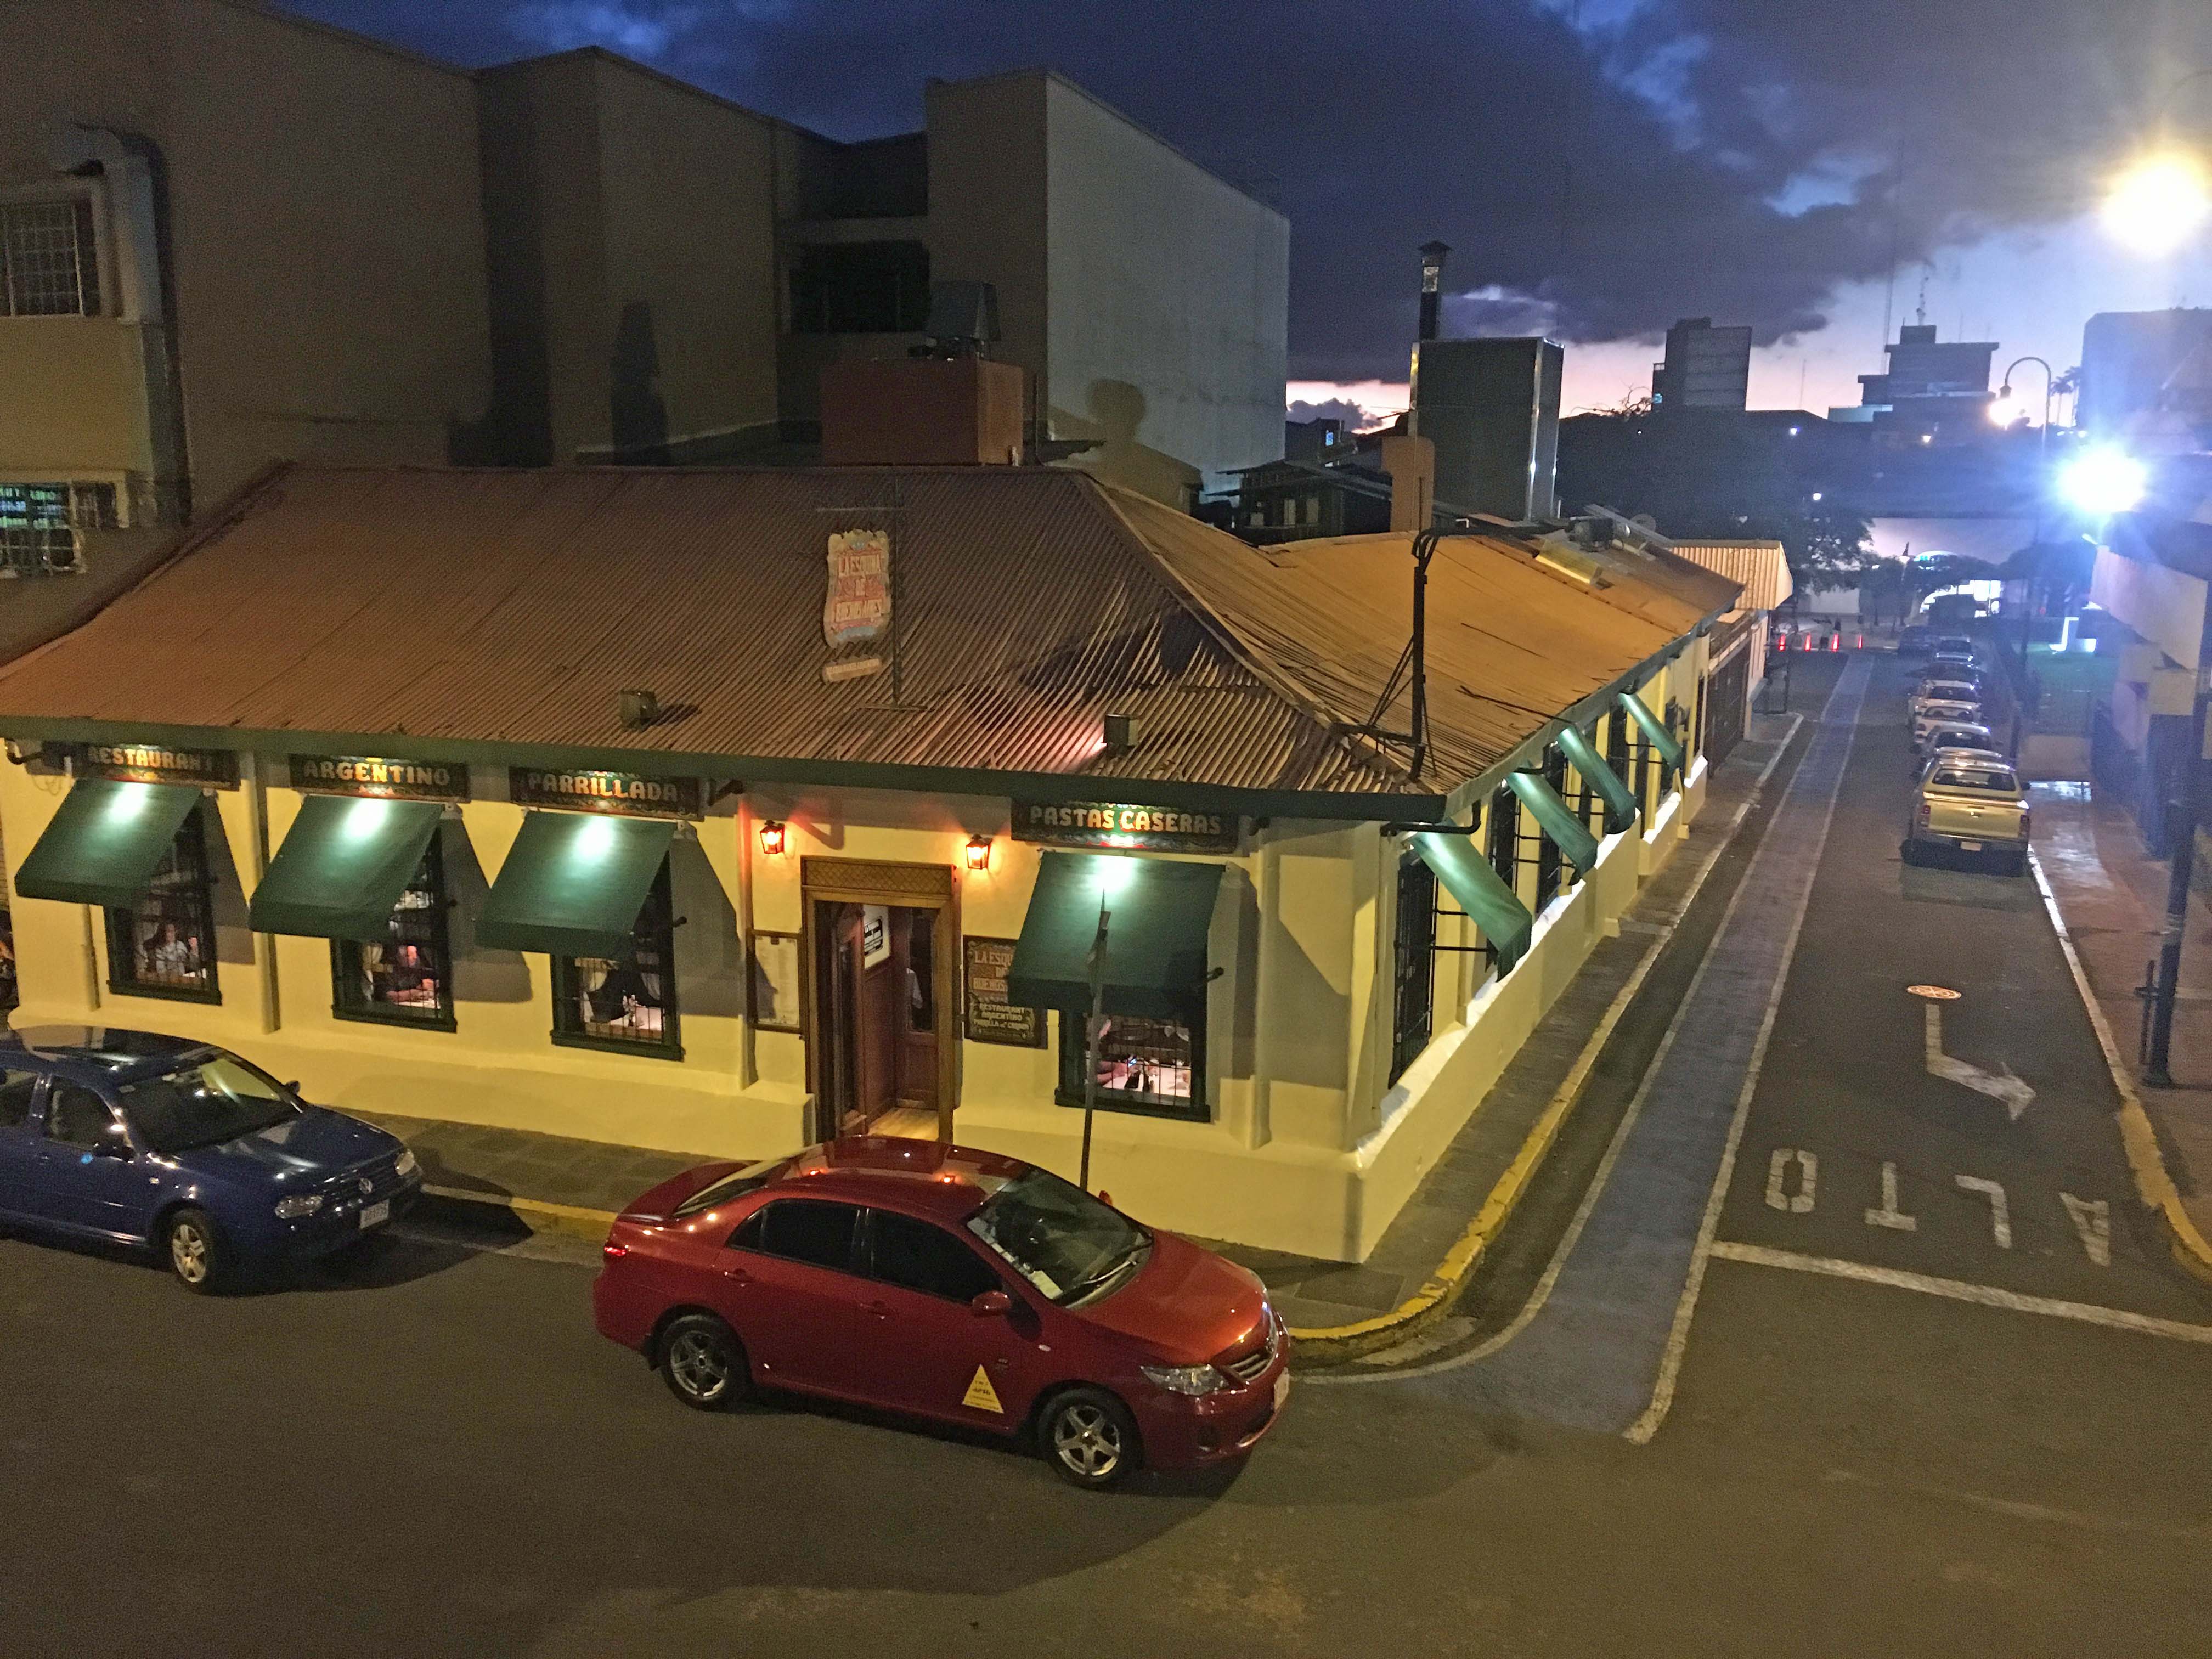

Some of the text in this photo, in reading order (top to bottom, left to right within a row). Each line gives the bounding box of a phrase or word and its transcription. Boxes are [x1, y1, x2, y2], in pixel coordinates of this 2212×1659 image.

[303, 760, 449, 785] ARGENTINO
[528, 772, 678, 802] PARRILLADA
[1030, 805, 1221, 834] PASTAS CASERAS
[974, 951, 988, 964] LA
[1765, 1148, 2111, 1267] ALTO
